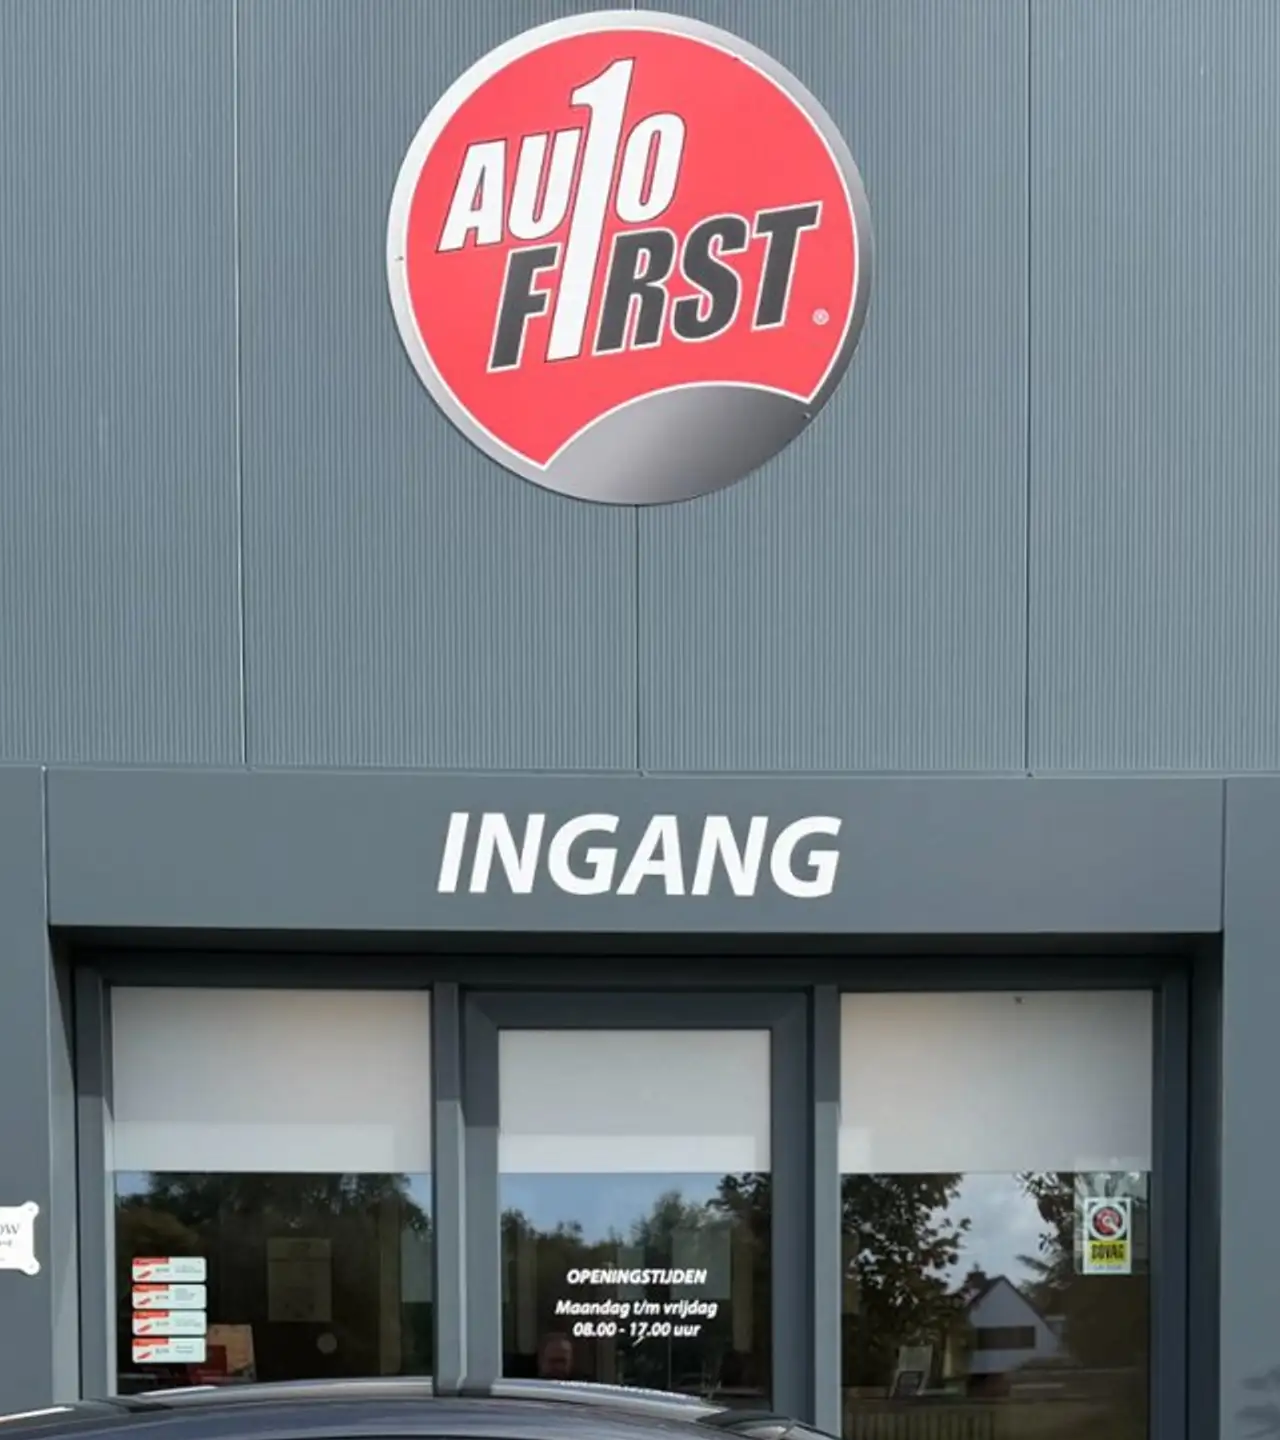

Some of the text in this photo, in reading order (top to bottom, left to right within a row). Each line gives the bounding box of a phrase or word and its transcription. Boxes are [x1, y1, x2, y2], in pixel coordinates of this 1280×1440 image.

[437, 812, 842, 898] INGANG
[566, 1268, 708, 1285] OPENINGSTIJDEN
[555, 1300, 718, 1318] Maandag t/m vrijdag
[572, 1322, 617, 1337] 08.00
[629, 1322, 671, 1337] 17.00
[673, 1325, 701, 1337] uur
